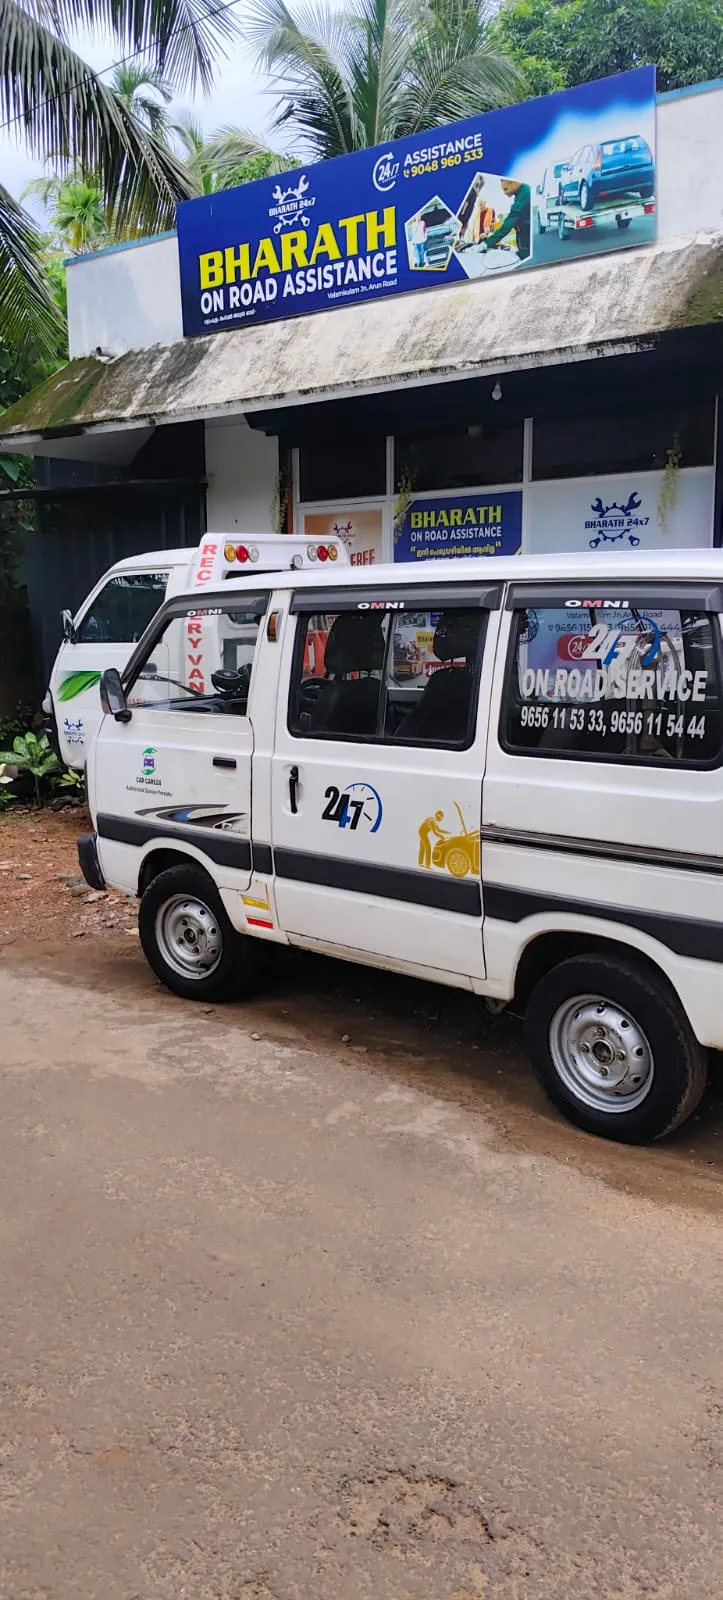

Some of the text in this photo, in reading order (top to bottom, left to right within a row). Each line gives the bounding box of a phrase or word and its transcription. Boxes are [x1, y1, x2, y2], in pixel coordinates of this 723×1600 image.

[404, 133, 482, 166] ASSISTANCE
[411, 148, 483, 177] 9048 960 533
[268, 197, 316, 216] BHARATH 24x7
[199, 206, 397, 290] BHARATH
[200, 249, 398, 315] ON ROAD ASSISTANCE
[382, 278, 398, 287] Road
[410, 505, 502, 529] BHARATH
[584, 517, 650, 529] BHARATH 24x7
[410, 526, 502, 542] ON ROAD ASSISTANCE
[187, 608, 222, 616] OMNI
[564, 600, 629, 608] OMNI
[555, 623, 578, 632] 9656
[187, 654, 205, 694] VAN
[523, 668, 709, 702] ON ROAD SERVICE
[520, 705, 706, 739] 9656 11 53 33, 9656 11 54 44
